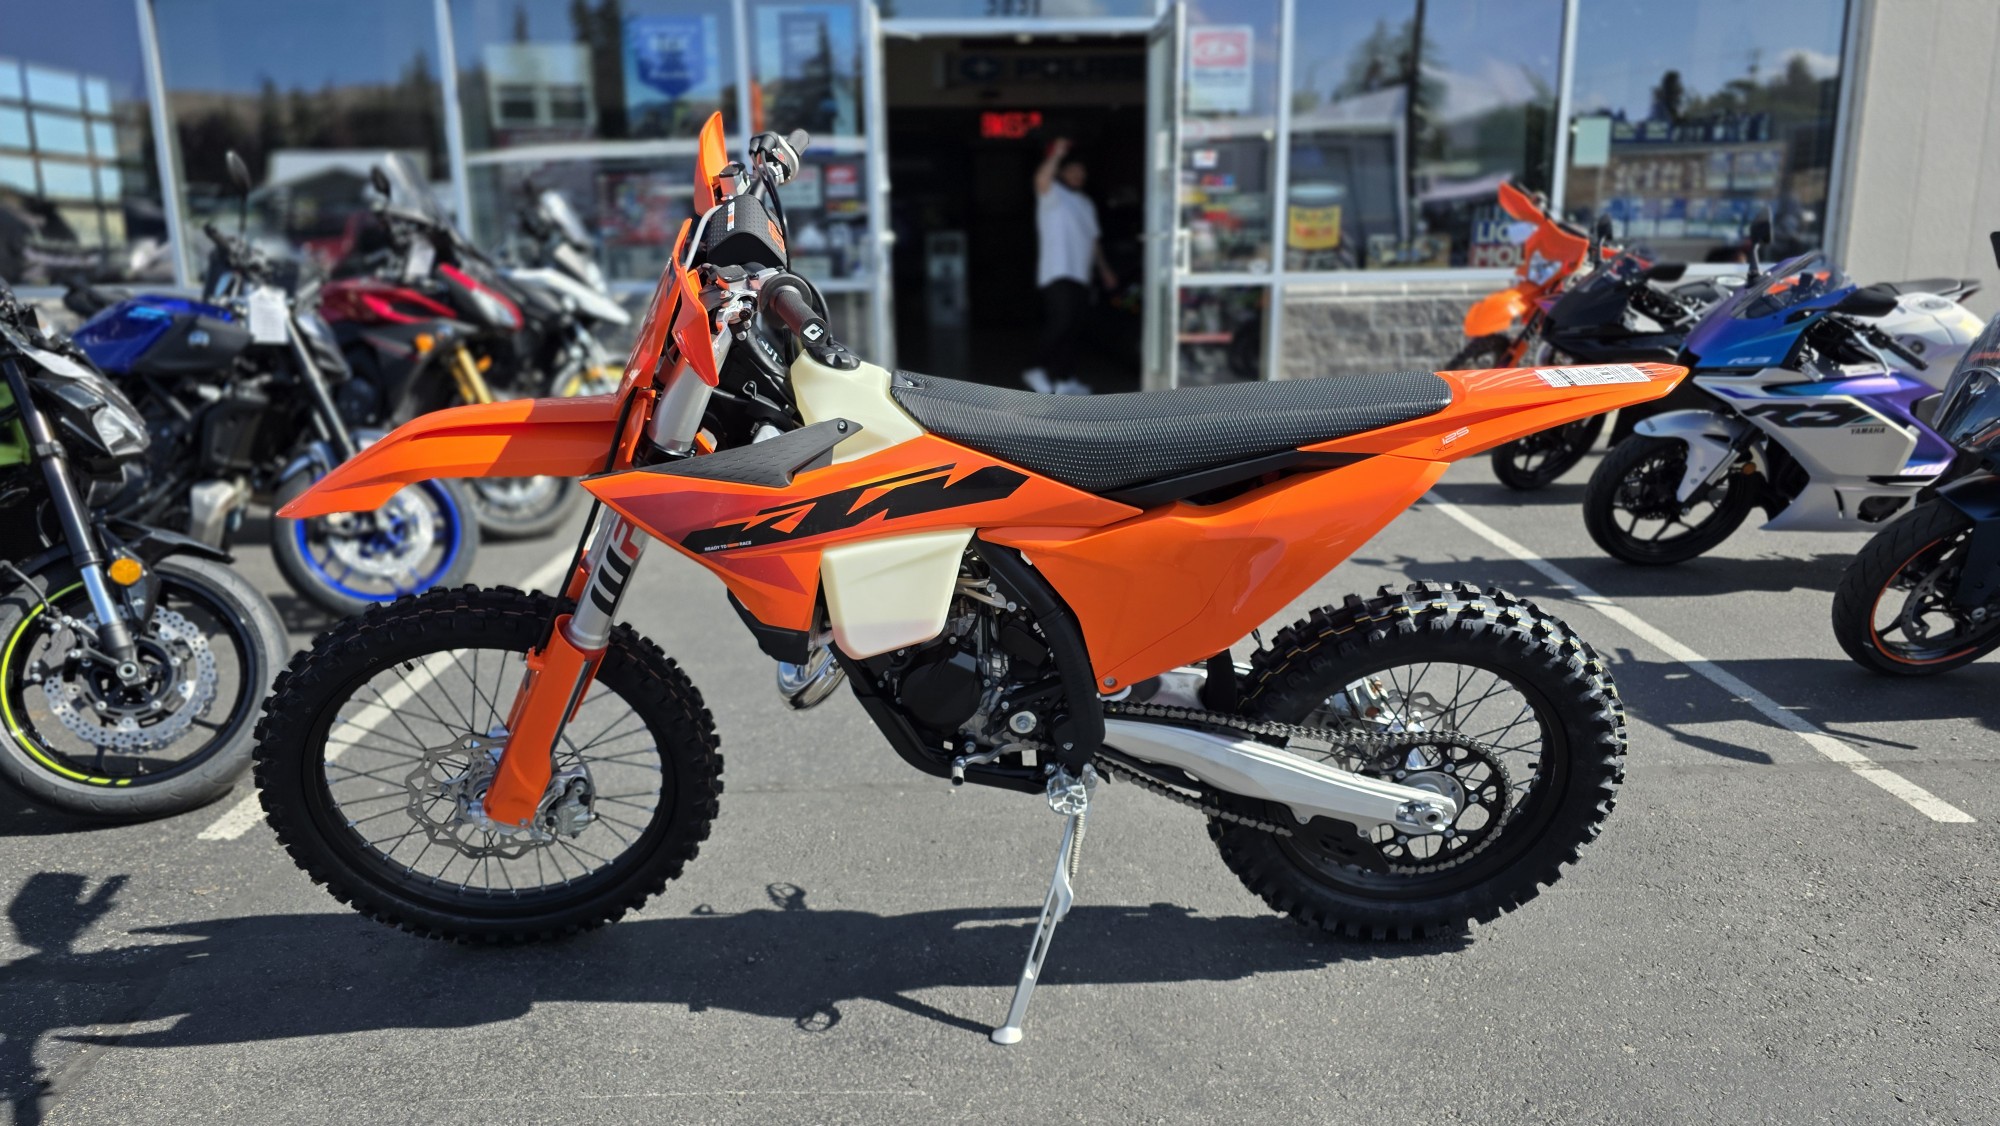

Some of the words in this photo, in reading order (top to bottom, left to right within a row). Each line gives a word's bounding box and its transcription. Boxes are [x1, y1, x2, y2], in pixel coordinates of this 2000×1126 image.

[1441, 426, 1470, 445] 125
[1850, 427, 1886, 435] YAMAHA
[680, 462, 1031, 554] KTM
